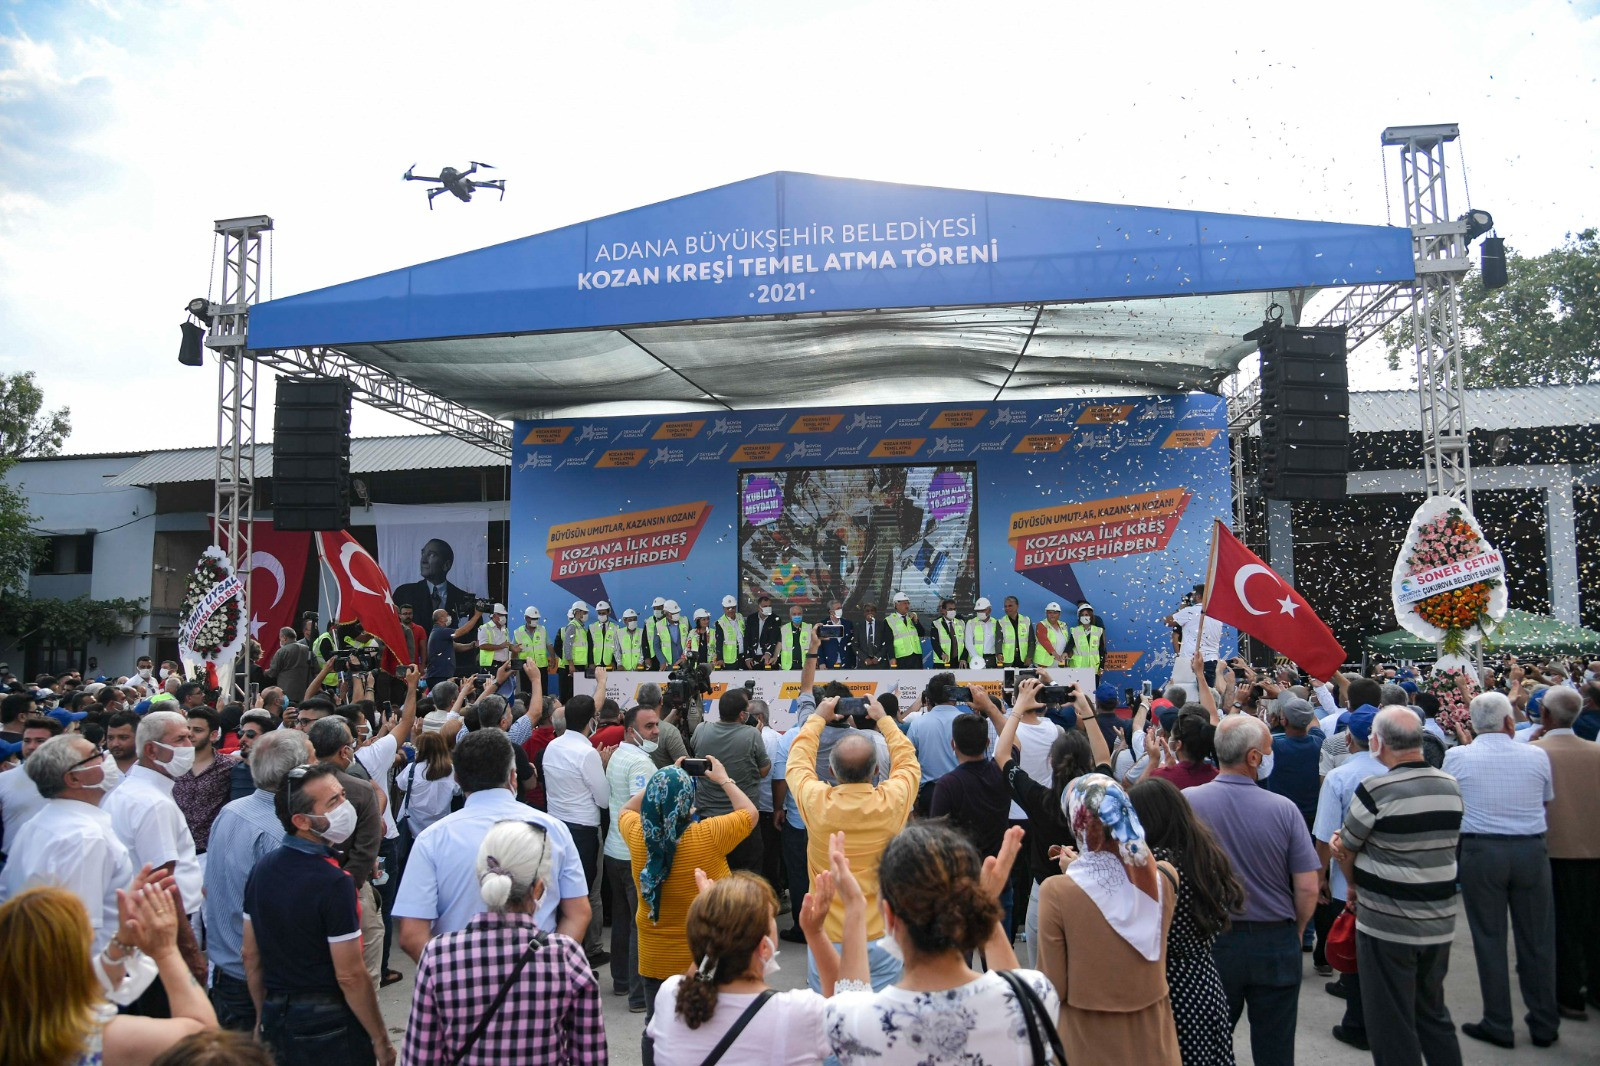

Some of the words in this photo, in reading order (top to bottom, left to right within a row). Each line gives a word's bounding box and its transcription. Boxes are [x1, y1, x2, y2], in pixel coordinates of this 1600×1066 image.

[595, 238, 678, 262] ADANA
[685, 223, 836, 254] BÜYÜKŞEHİR
[842, 213, 976, 242] BELEDİYESİ
[577, 267, 660, 290] KOZAN
[666, 254, 734, 284] KREŞİ
[738, 254, 818, 277] TEMEL
[824, 249, 898, 271] ATMA
[901, 238, 998, 268] TÖRENİ
[746, 488, 776, 503] KUBİLAY
[746, 500, 778, 514] MEYDANI
[551, 528, 586, 541] BÜYÜSÜN
[588, 523, 625, 535] UMUTLAR,
[626, 516, 665, 529] KAZANSIN
[667, 511, 696, 523] KOZAN!
[1013, 515, 1052, 530] BÜYÜSÜN
[1054, 510, 1096, 523] UMUTLAR,
[1142, 498, 1174, 510] KOZAN!
[1099, 525, 1122, 540] İLK
[1127, 520, 1165, 535] KREŞ
[562, 542, 622, 561] KOZAN'A
[626, 535, 648, 550] İLK
[652, 532, 687, 547] KREŞ
[1024, 537, 1157, 566] BÜYÜKŞEHİRDEN
[559, 548, 679, 576] BÜYÜKŞEHİRDEN
[1417, 565, 1462, 585] SONER
[1464, 553, 1499, 572] ÇETİN
[205, 576, 236, 605] UYSAL
[1422, 581, 1453, 595] ÇUKUROVA
[1454, 573, 1479, 585] BELEDİYE
[1479, 565, 1501, 577] BAŞKANI
